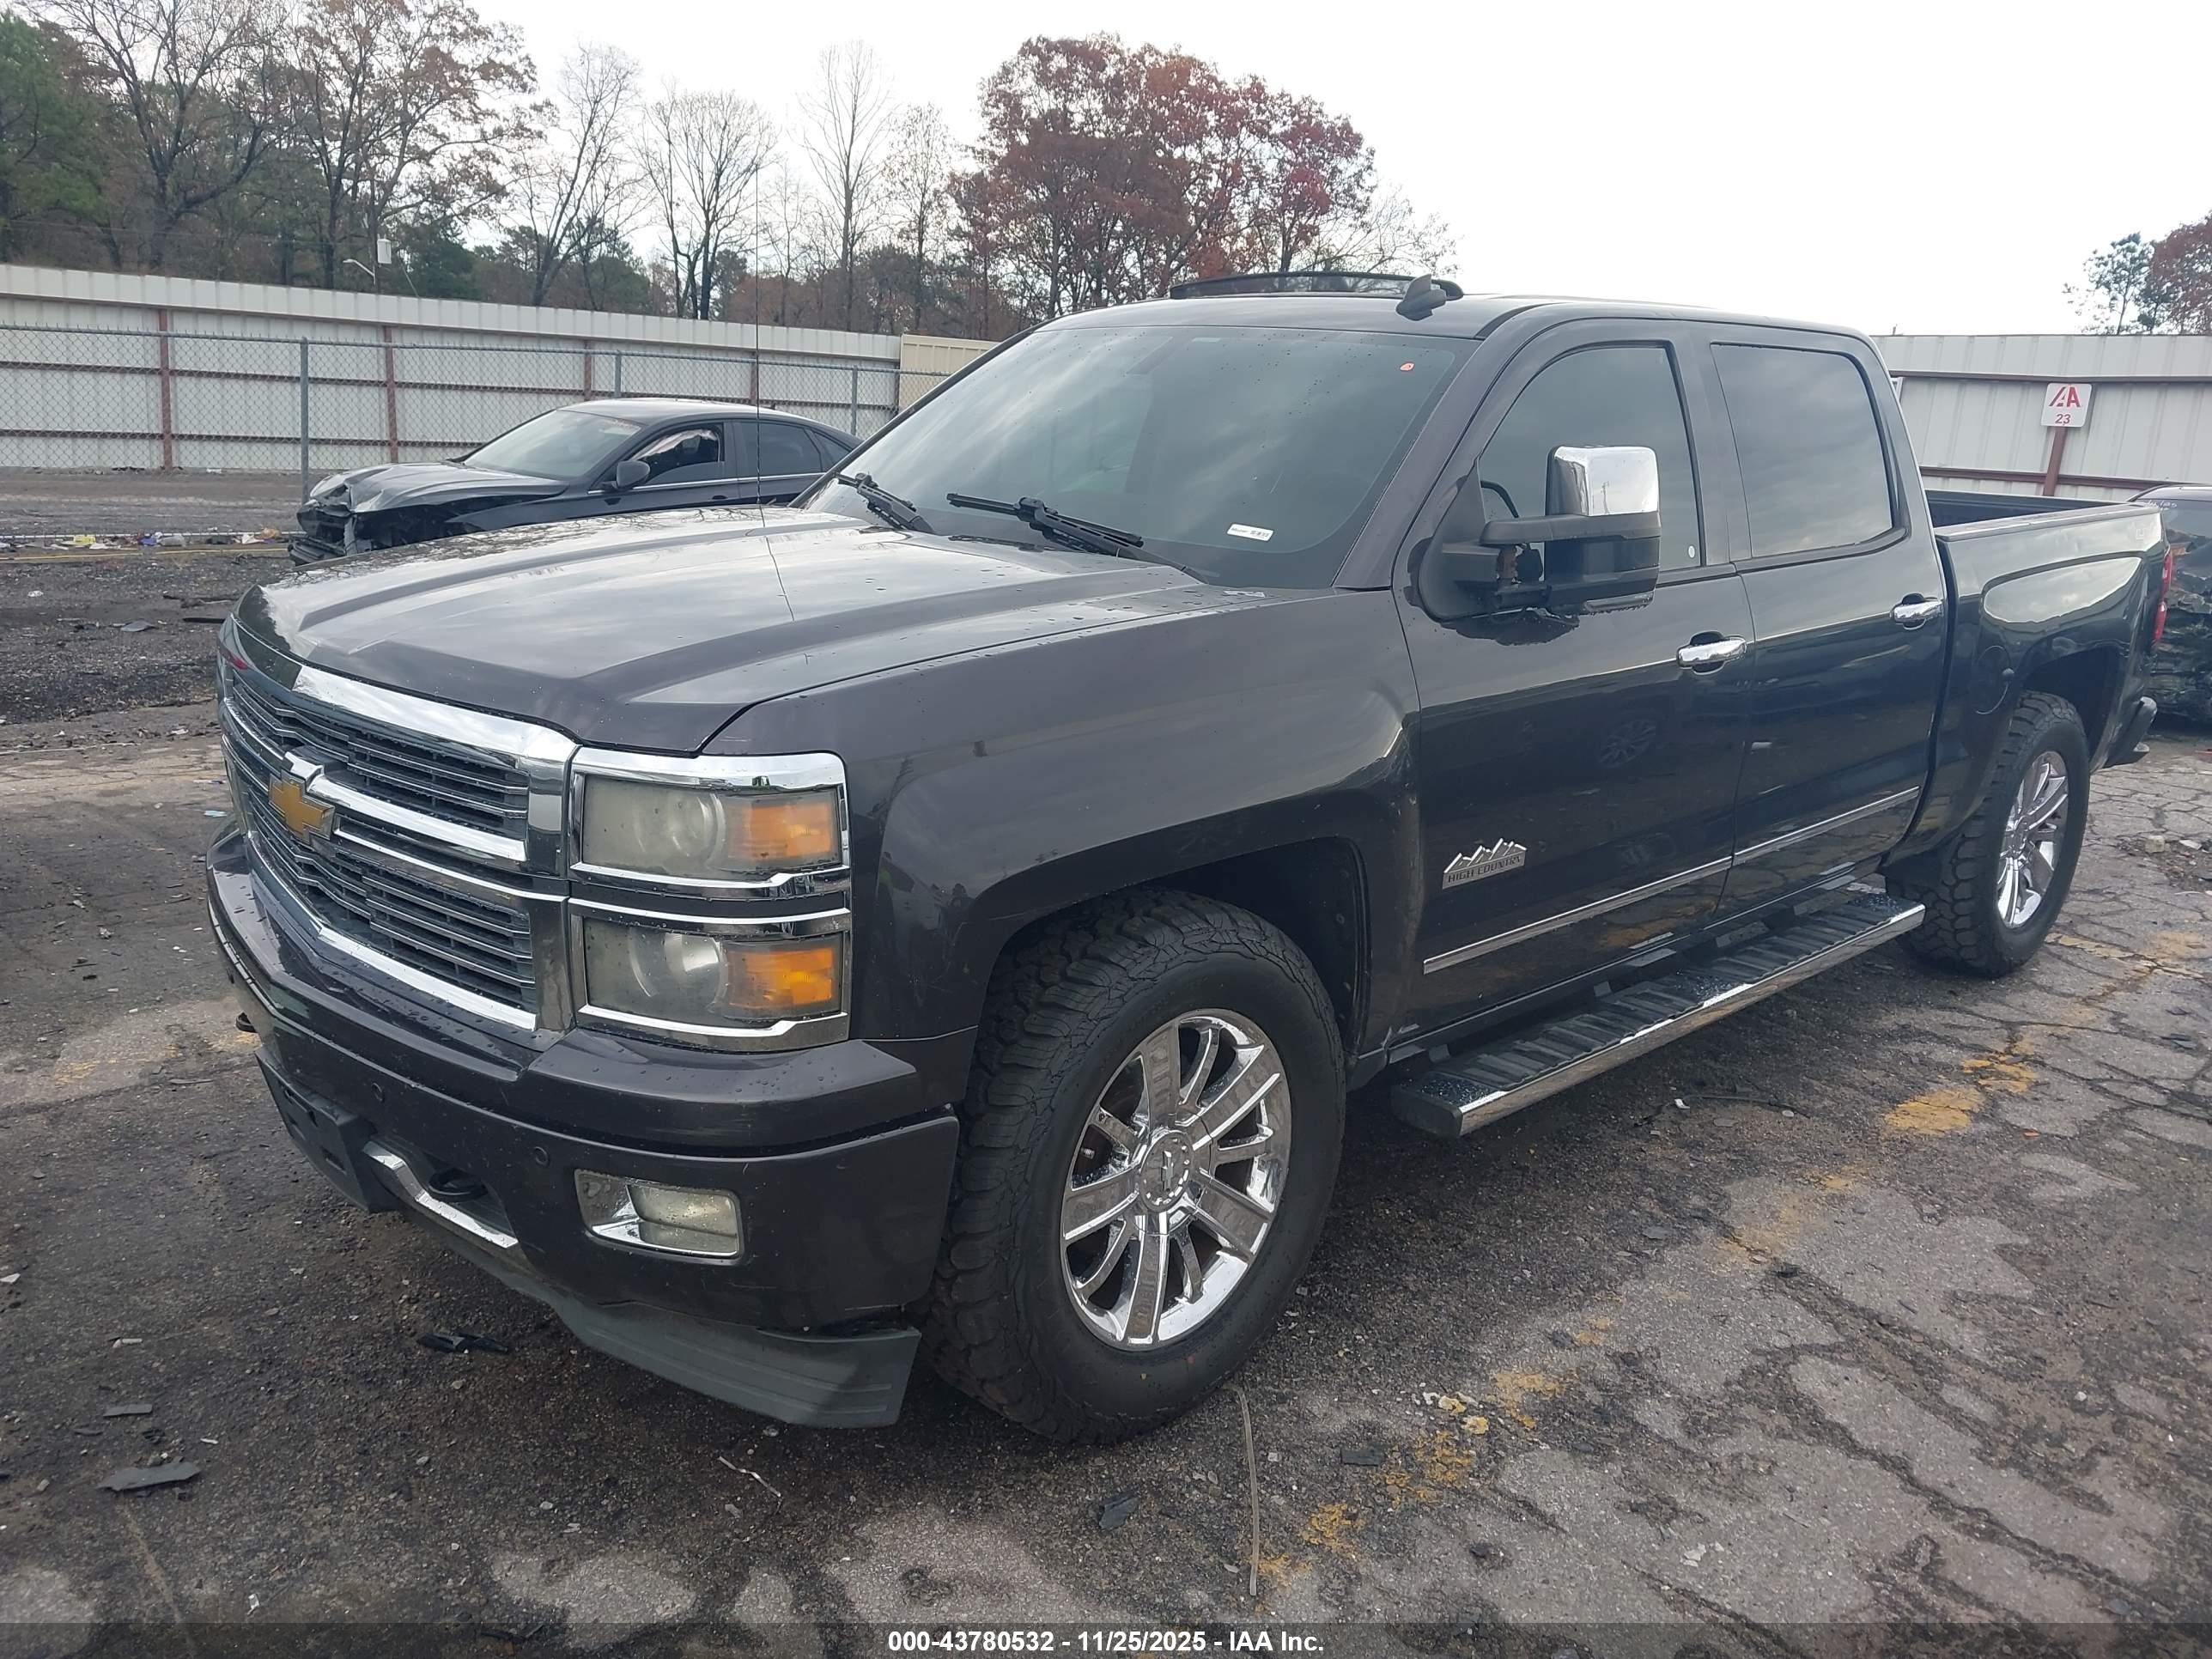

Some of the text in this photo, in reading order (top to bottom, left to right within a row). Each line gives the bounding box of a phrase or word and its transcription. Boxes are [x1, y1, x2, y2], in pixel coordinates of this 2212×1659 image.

[2055, 413, 2071, 424] 23
[1448, 855, 1521, 883] HIGH COUNTRY
